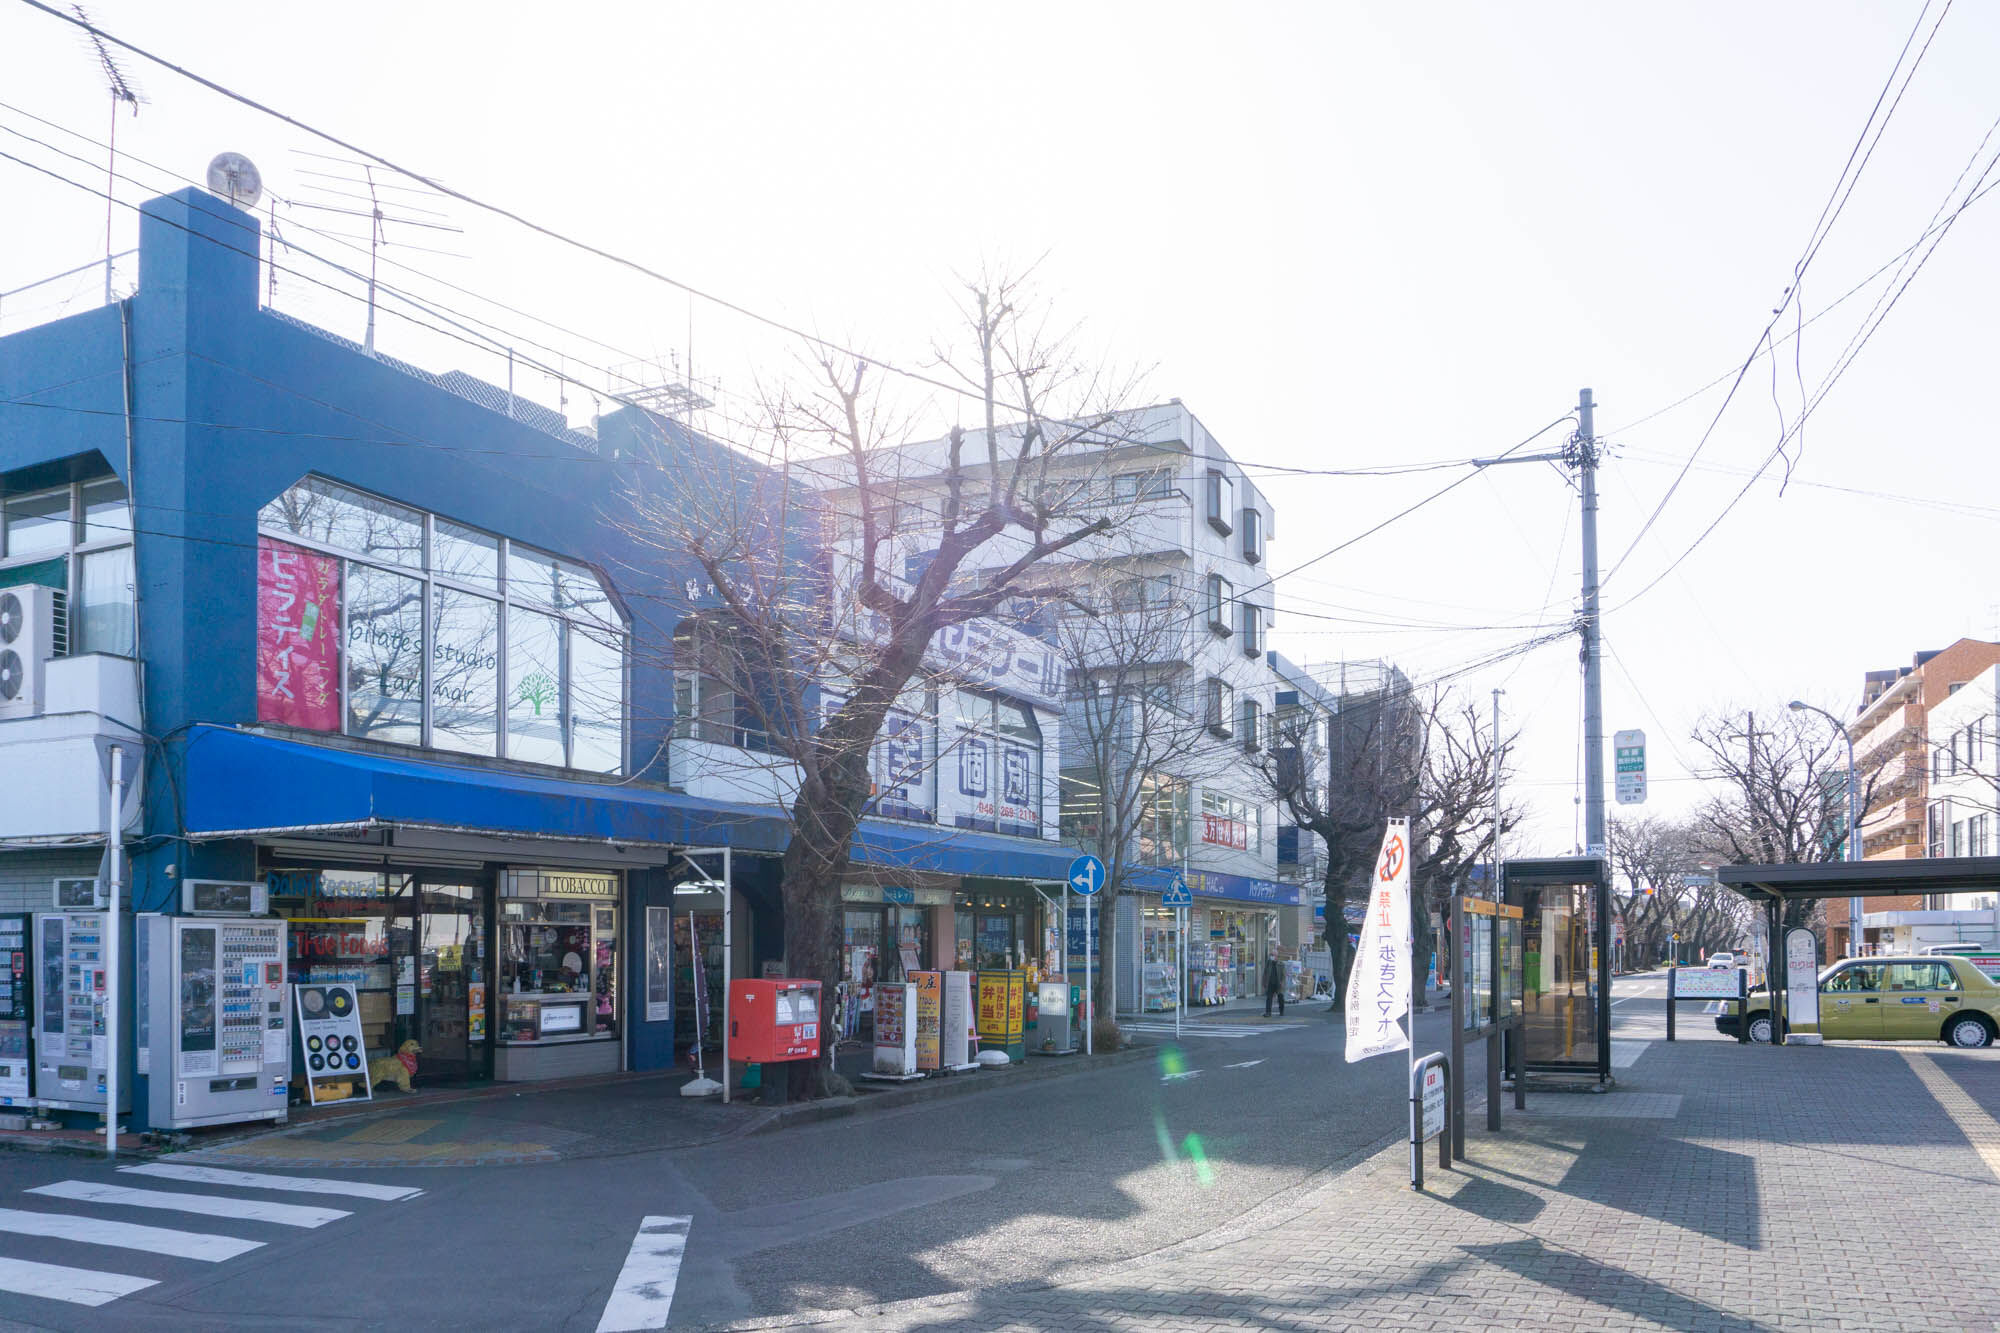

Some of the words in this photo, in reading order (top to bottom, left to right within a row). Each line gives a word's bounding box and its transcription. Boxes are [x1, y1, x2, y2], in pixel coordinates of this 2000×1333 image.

[271, 551, 298, 699] ピラティス
[317, 561, 330, 706] カラダトレーニング
[348, 622, 422, 655] pilates
[434, 643, 497, 670] studio
[552, 876, 606, 895] TOBACCO
[295, 932, 337, 956] True
[340, 932, 389, 956] Foods
[1789, 960, 1814, 969] のりば
[982, 984, 995, 1019] 弁当
